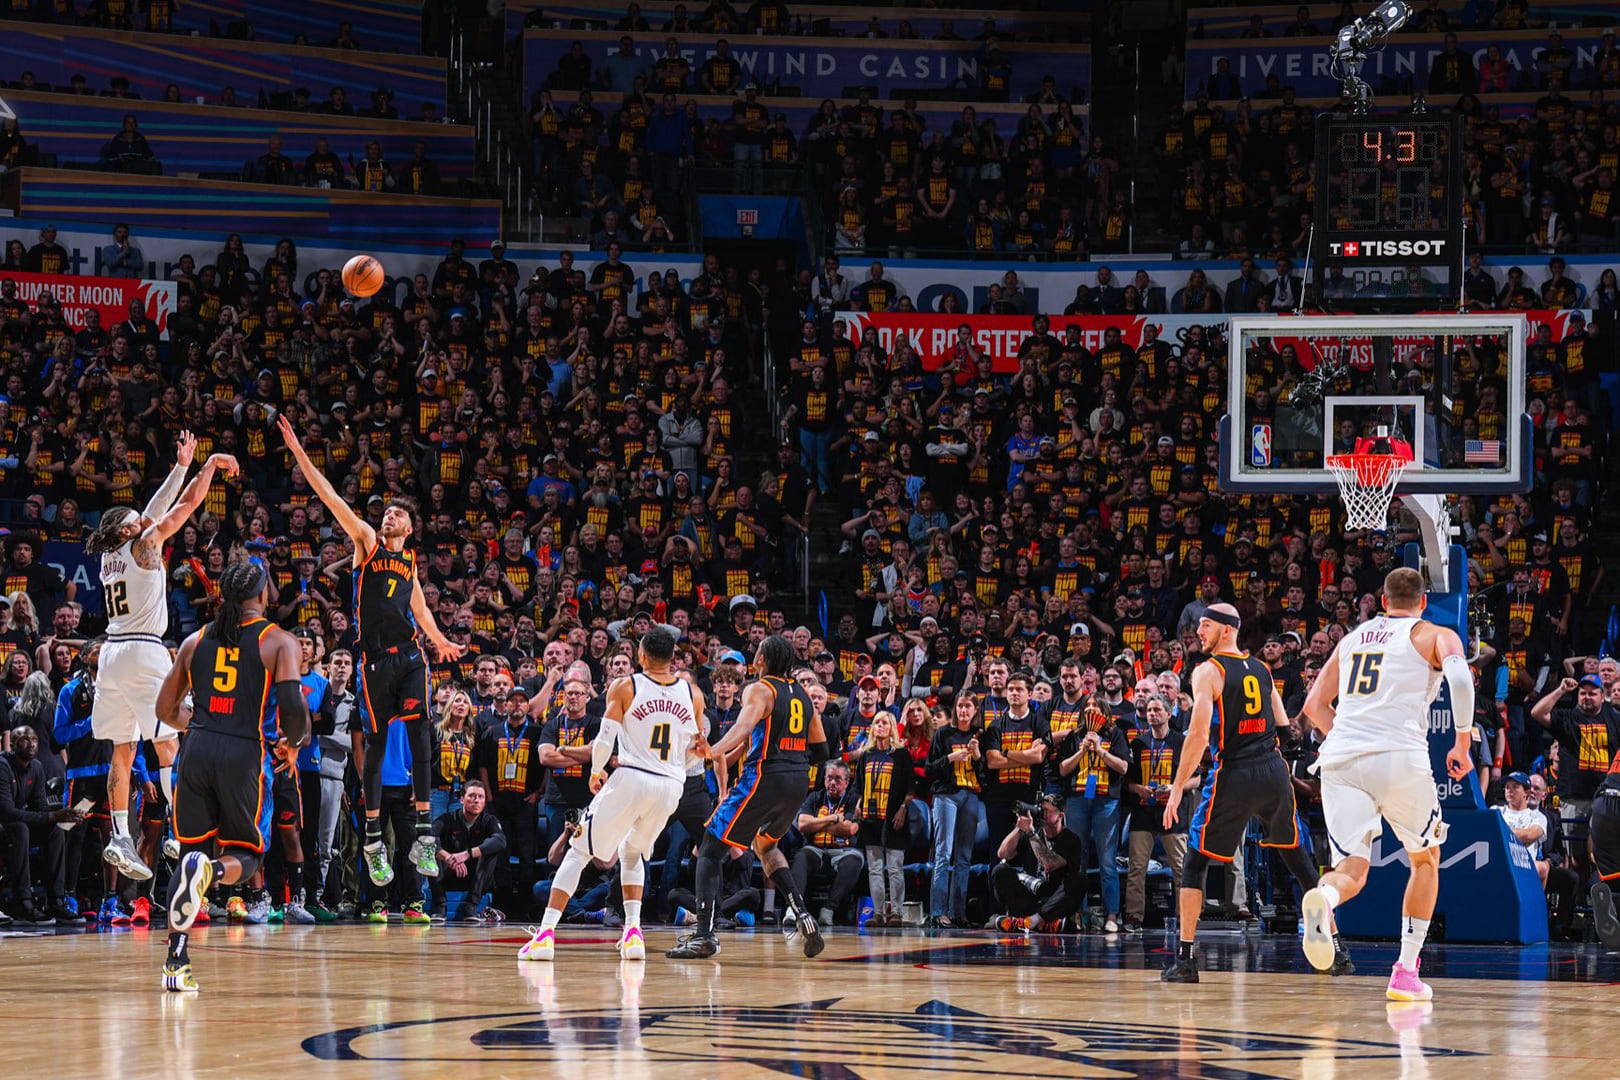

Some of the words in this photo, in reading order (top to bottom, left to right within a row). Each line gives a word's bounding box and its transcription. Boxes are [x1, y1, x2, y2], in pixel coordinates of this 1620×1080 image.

[858, 54, 978, 80] CASIN
[1363, 131, 1415, 162] 4.3
[1361, 240, 1446, 256] TISSOT
[79, 285, 123, 306] MOON
[386, 578, 398, 599] 7
[212, 646, 240, 693] 5
[1346, 652, 1384, 696] 15
[1242, 674, 1263, 716] 9
[631, 699, 693, 725] WESTBROOK
[789, 698, 804, 735] 8
[650, 722, 672, 761] 4
